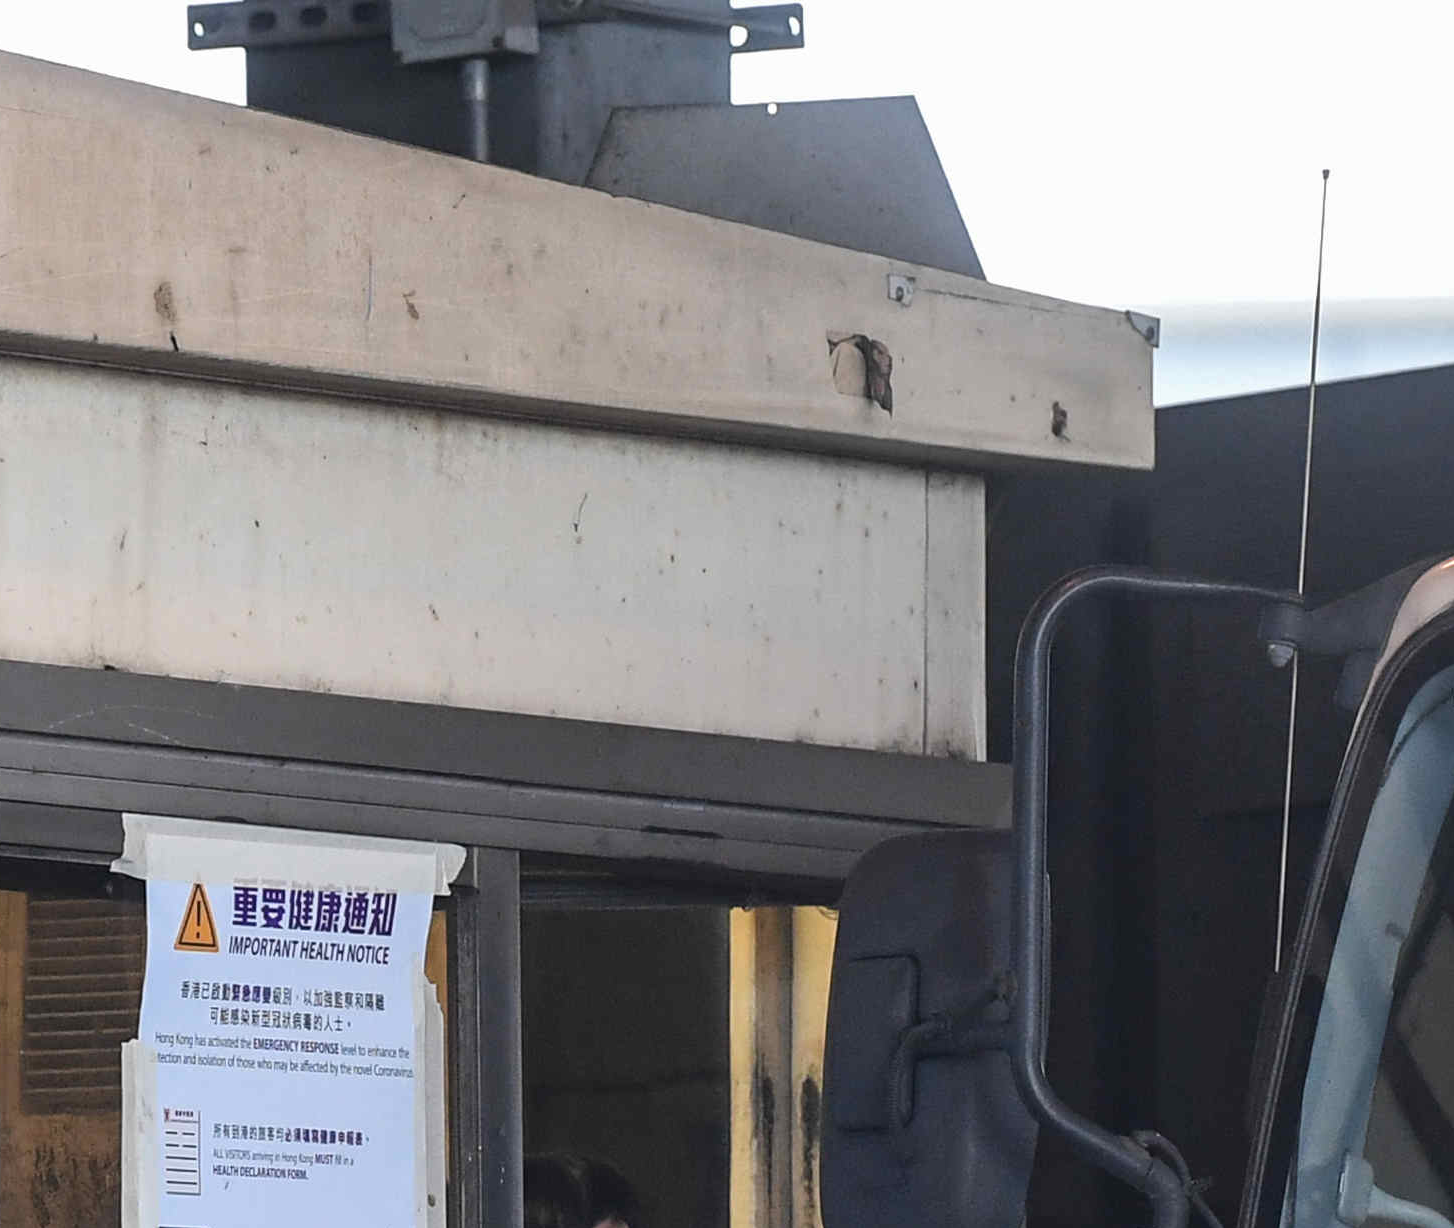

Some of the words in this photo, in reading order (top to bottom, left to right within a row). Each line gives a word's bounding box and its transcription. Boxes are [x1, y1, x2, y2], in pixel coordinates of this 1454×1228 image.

[232, 886, 397, 936] 重要健康通知
[229, 936, 299, 959] IMPORTANT
[300, 941, 344, 962] HEALTH
[347, 944, 390, 965] NOTICE
[155, 1032, 174, 1047] Hong
[176, 1034, 193, 1048] Kong
[253, 1038, 299, 1053] EMERGENCY
[301, 1041, 339, 1055] RESPONSE
[314, 1154, 333, 1165] MUST
[213, 1165, 239, 1177] HEALTH
[240, 1166, 286, 1179] DECLARATION
